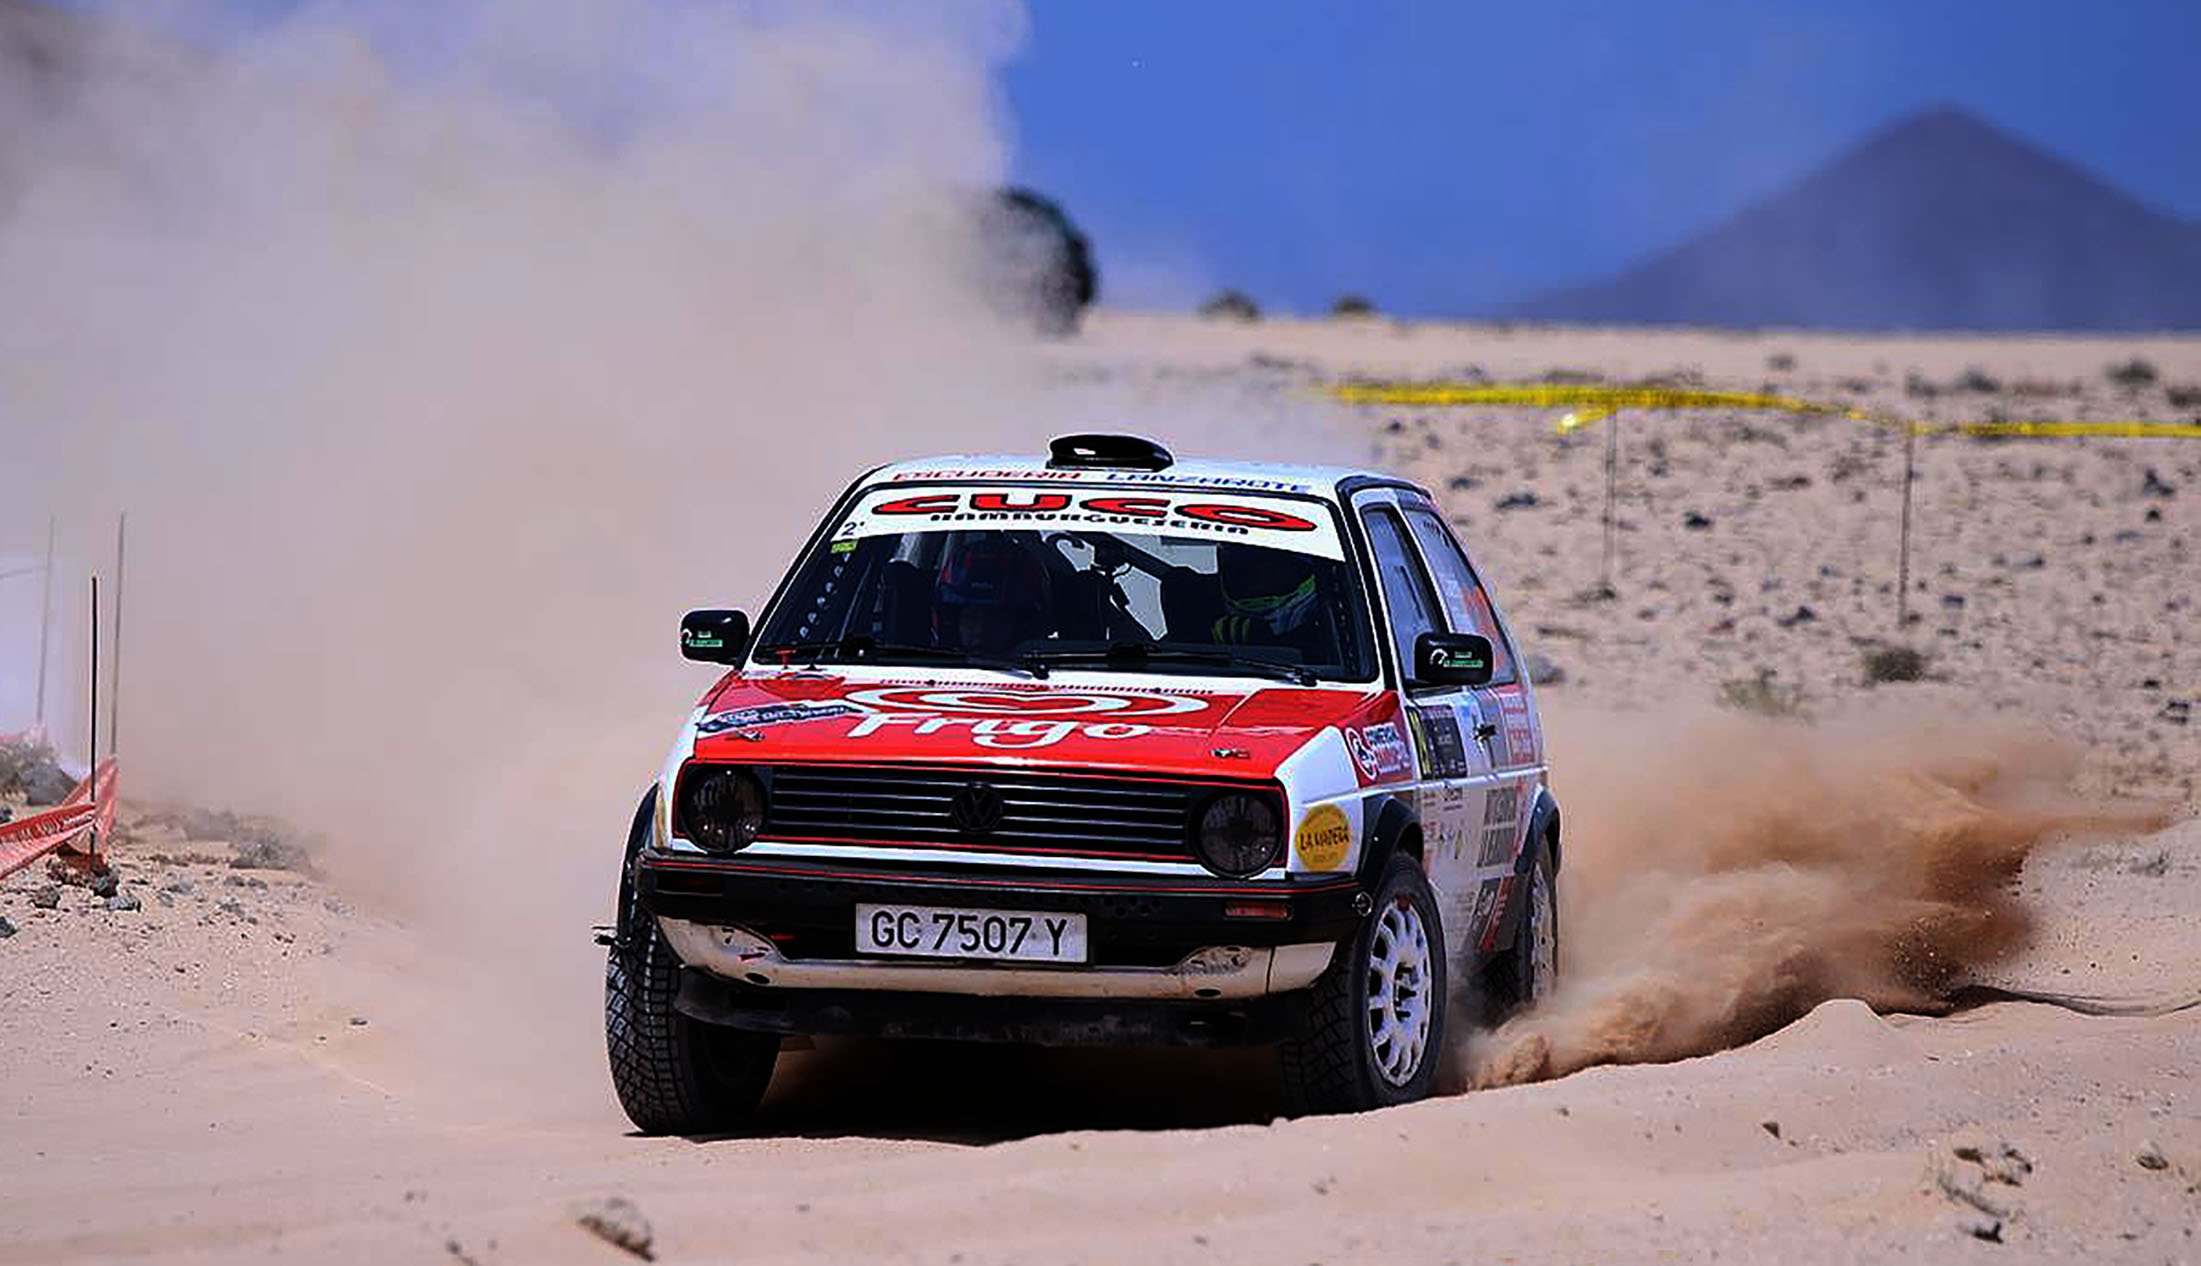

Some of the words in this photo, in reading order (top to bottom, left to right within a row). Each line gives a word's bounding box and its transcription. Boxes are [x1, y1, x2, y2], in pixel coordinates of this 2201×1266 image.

[892, 471, 1082, 482] ESCUDERIA
[1106, 473, 1312, 492] LANZAROTE
[870, 493, 1318, 532] CUCO
[930, 512, 1249, 535] HAMBURGUESERIA
[847, 712, 1151, 749] Frigo
[871, 910, 920, 950] GC
[932, 913, 1032, 955] 7507
[1045, 918, 1067, 956] Y
